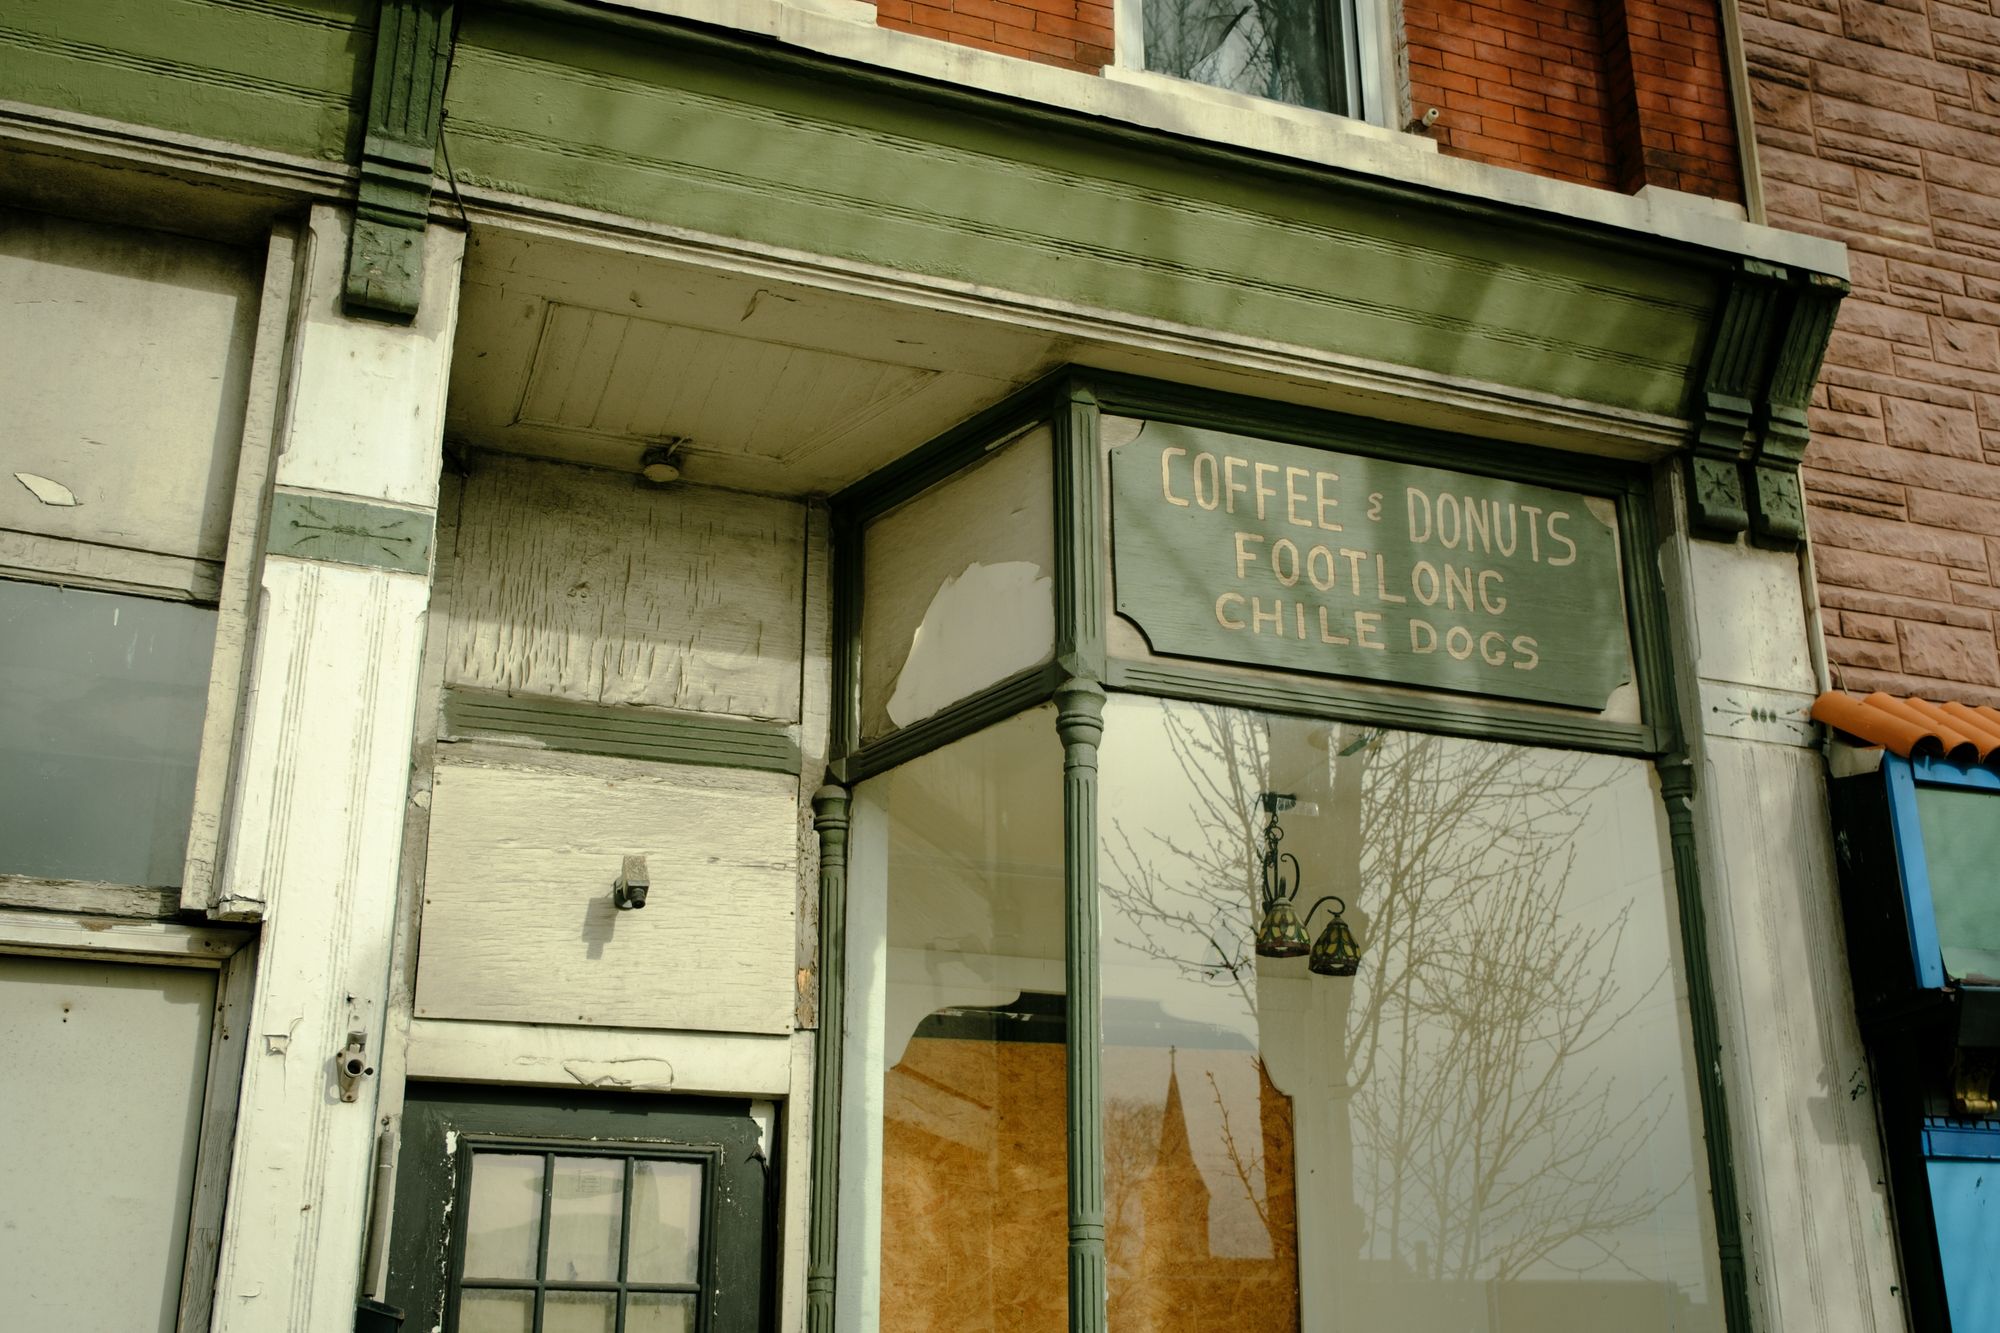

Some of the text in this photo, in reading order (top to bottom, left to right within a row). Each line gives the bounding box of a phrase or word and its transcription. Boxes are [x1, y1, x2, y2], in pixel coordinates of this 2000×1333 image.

[1161, 447, 1342, 531] COFFEE
[1406, 487, 1577, 566] DONUTS
[1235, 532, 1507, 615] FOOTLONG
[1215, 592, 1539, 671] CHILE DOGS
